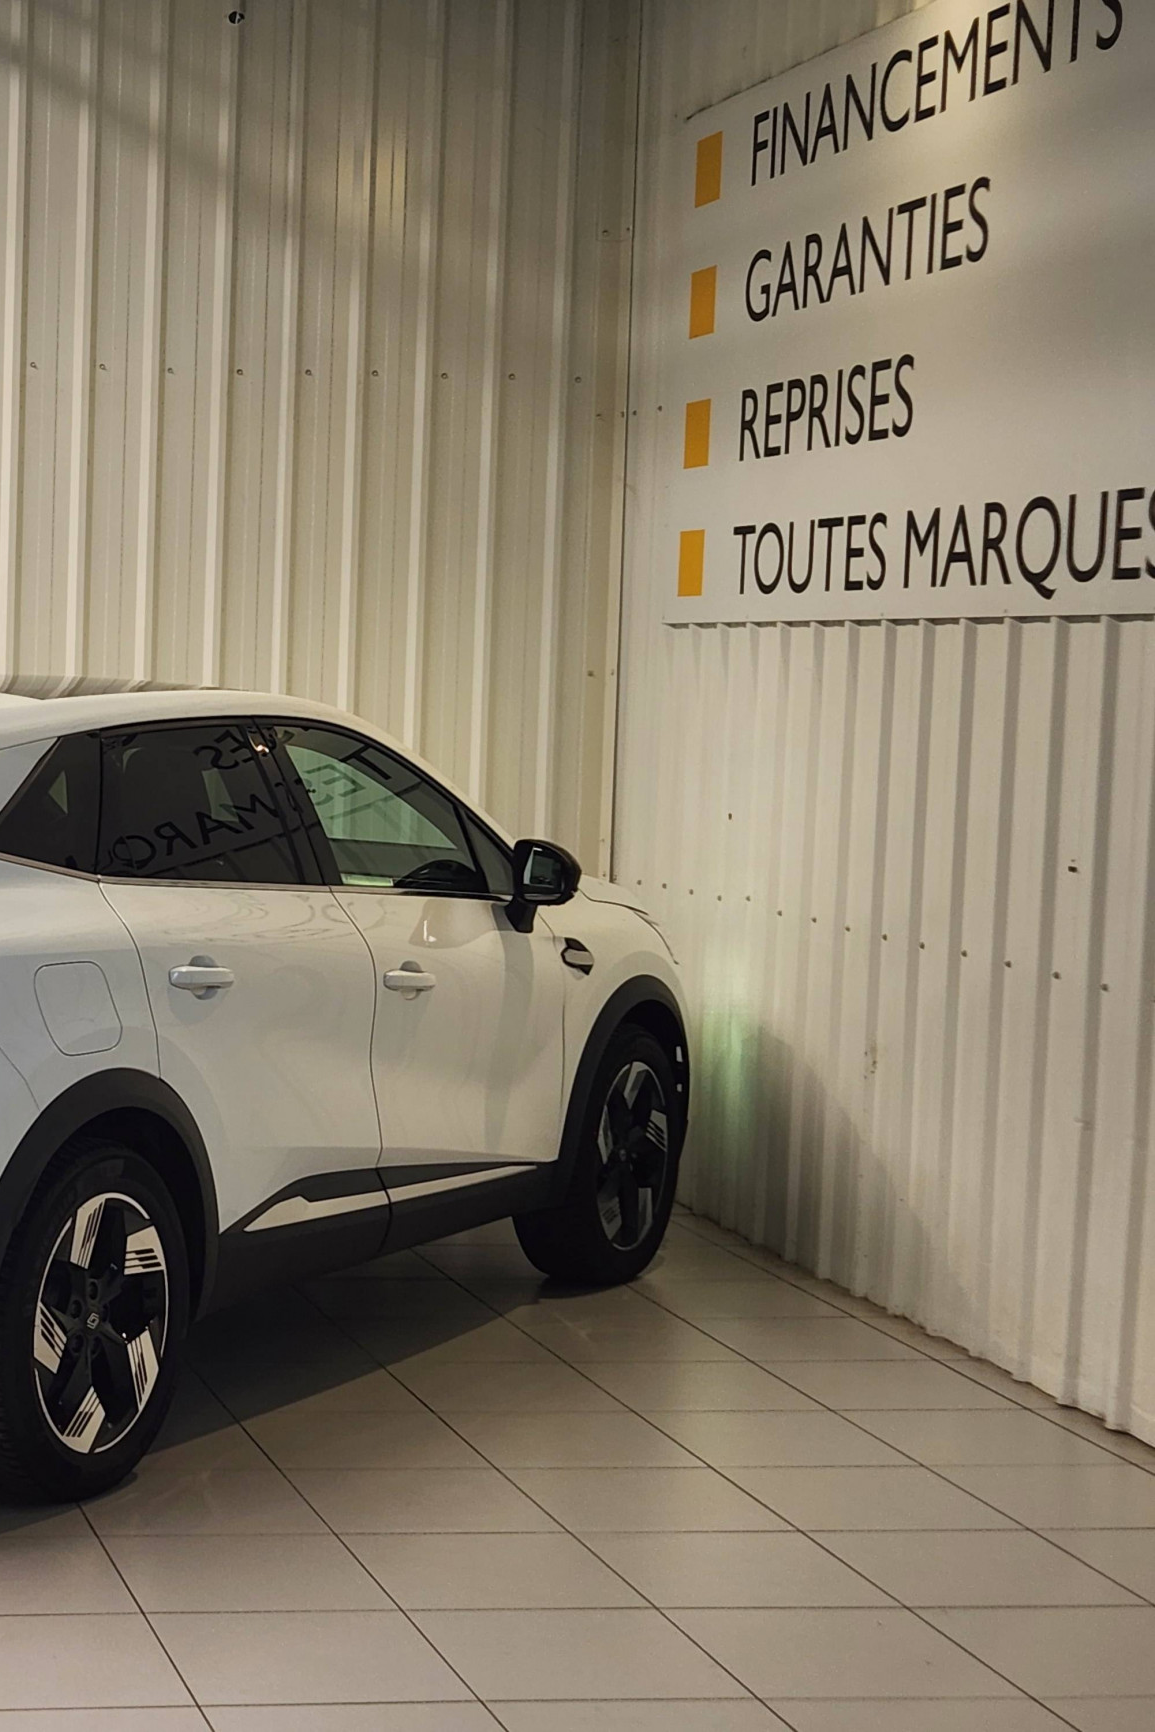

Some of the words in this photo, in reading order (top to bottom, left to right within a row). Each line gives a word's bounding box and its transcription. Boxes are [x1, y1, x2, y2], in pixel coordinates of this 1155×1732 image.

[745, 176, 992, 323] GARANTIES
[738, 353, 916, 463] REPRISES
[732, 511, 888, 596] TOUTES
